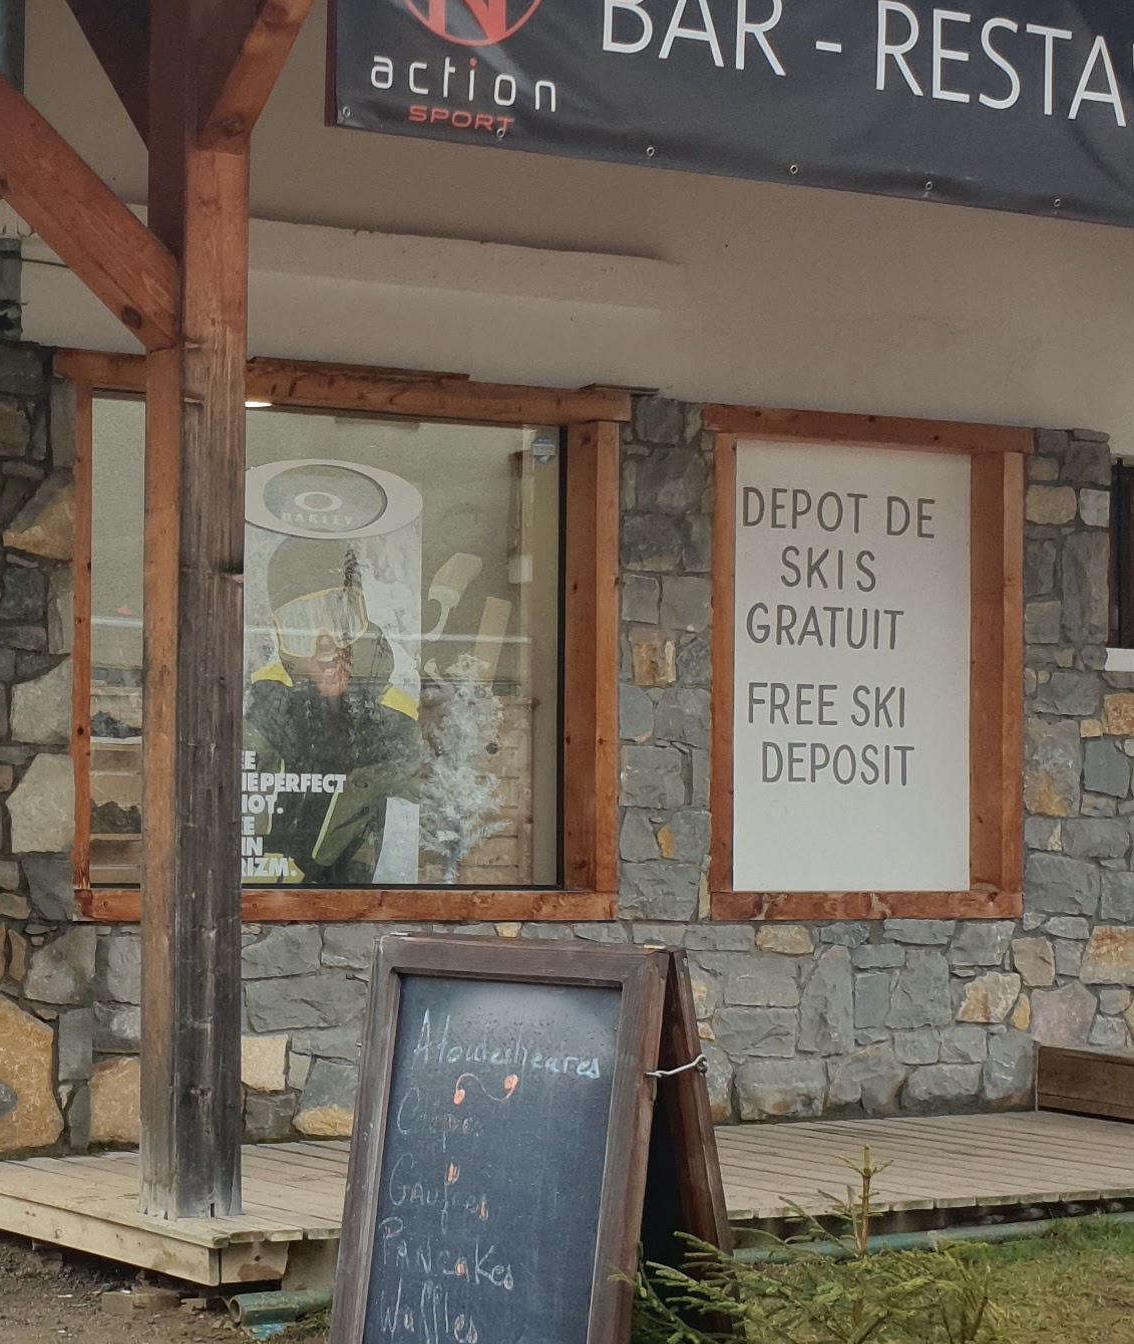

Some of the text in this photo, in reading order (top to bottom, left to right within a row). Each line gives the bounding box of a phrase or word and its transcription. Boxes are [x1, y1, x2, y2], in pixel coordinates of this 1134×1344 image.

[371, 54, 557, 113] action
[876, 0, 1134, 127] RESTA
[409, 104, 515, 132] SPORT
[742, 486, 936, 539] DEPOT DE
[780, 546, 877, 593] SKIS
[746, 602, 905, 651] GRATUIT
[748, 682, 906, 729] FREE SKI
[260, 773, 347, 793] PERFECT
[762, 741, 915, 787] DEPOSIT
